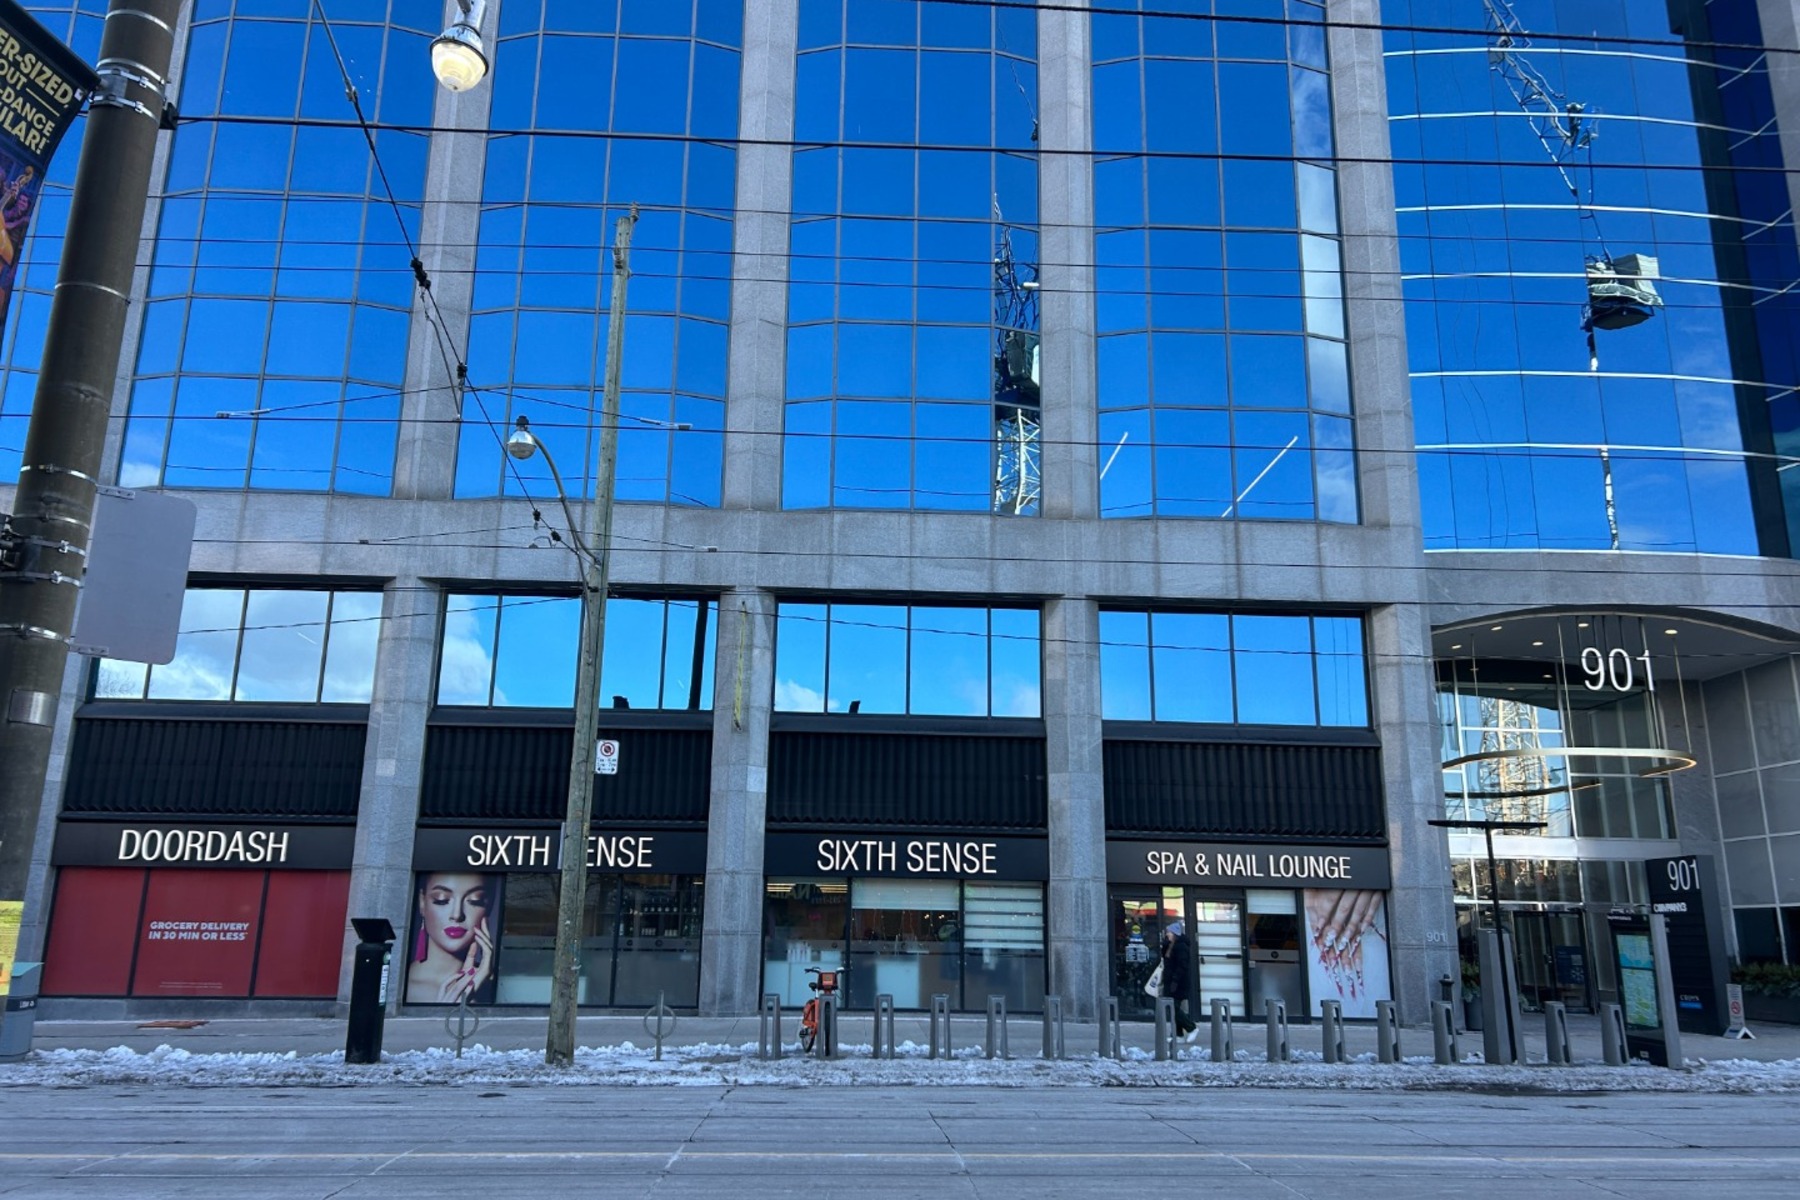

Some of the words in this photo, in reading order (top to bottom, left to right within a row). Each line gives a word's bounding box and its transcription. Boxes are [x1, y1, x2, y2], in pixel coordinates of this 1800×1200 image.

[1581, 647, 1654, 692] 901
[118, 829, 289, 863] DOORDASH
[467, 835, 550, 866] SIXTH
[586, 836, 654, 867] ENSE
[817, 839, 896, 871] SIXTH
[906, 841, 997, 873] SENSE
[1146, 851, 1188, 875] SPA
[1194, 853, 1211, 876] &
[1216, 853, 1264, 877] NAIL
[1269, 854, 1352, 879] LOUNGE
[1667, 859, 1700, 890] 901
[148, 931, 161, 940] IN
[162, 931, 176, 940] 30
[178, 931, 199, 940] MIN
[201, 932, 218, 941] OR
[150, 921, 199, 930] GROCERY
[200, 922, 249, 931] DELIVERY
[1426, 931, 1446, 942] 901
